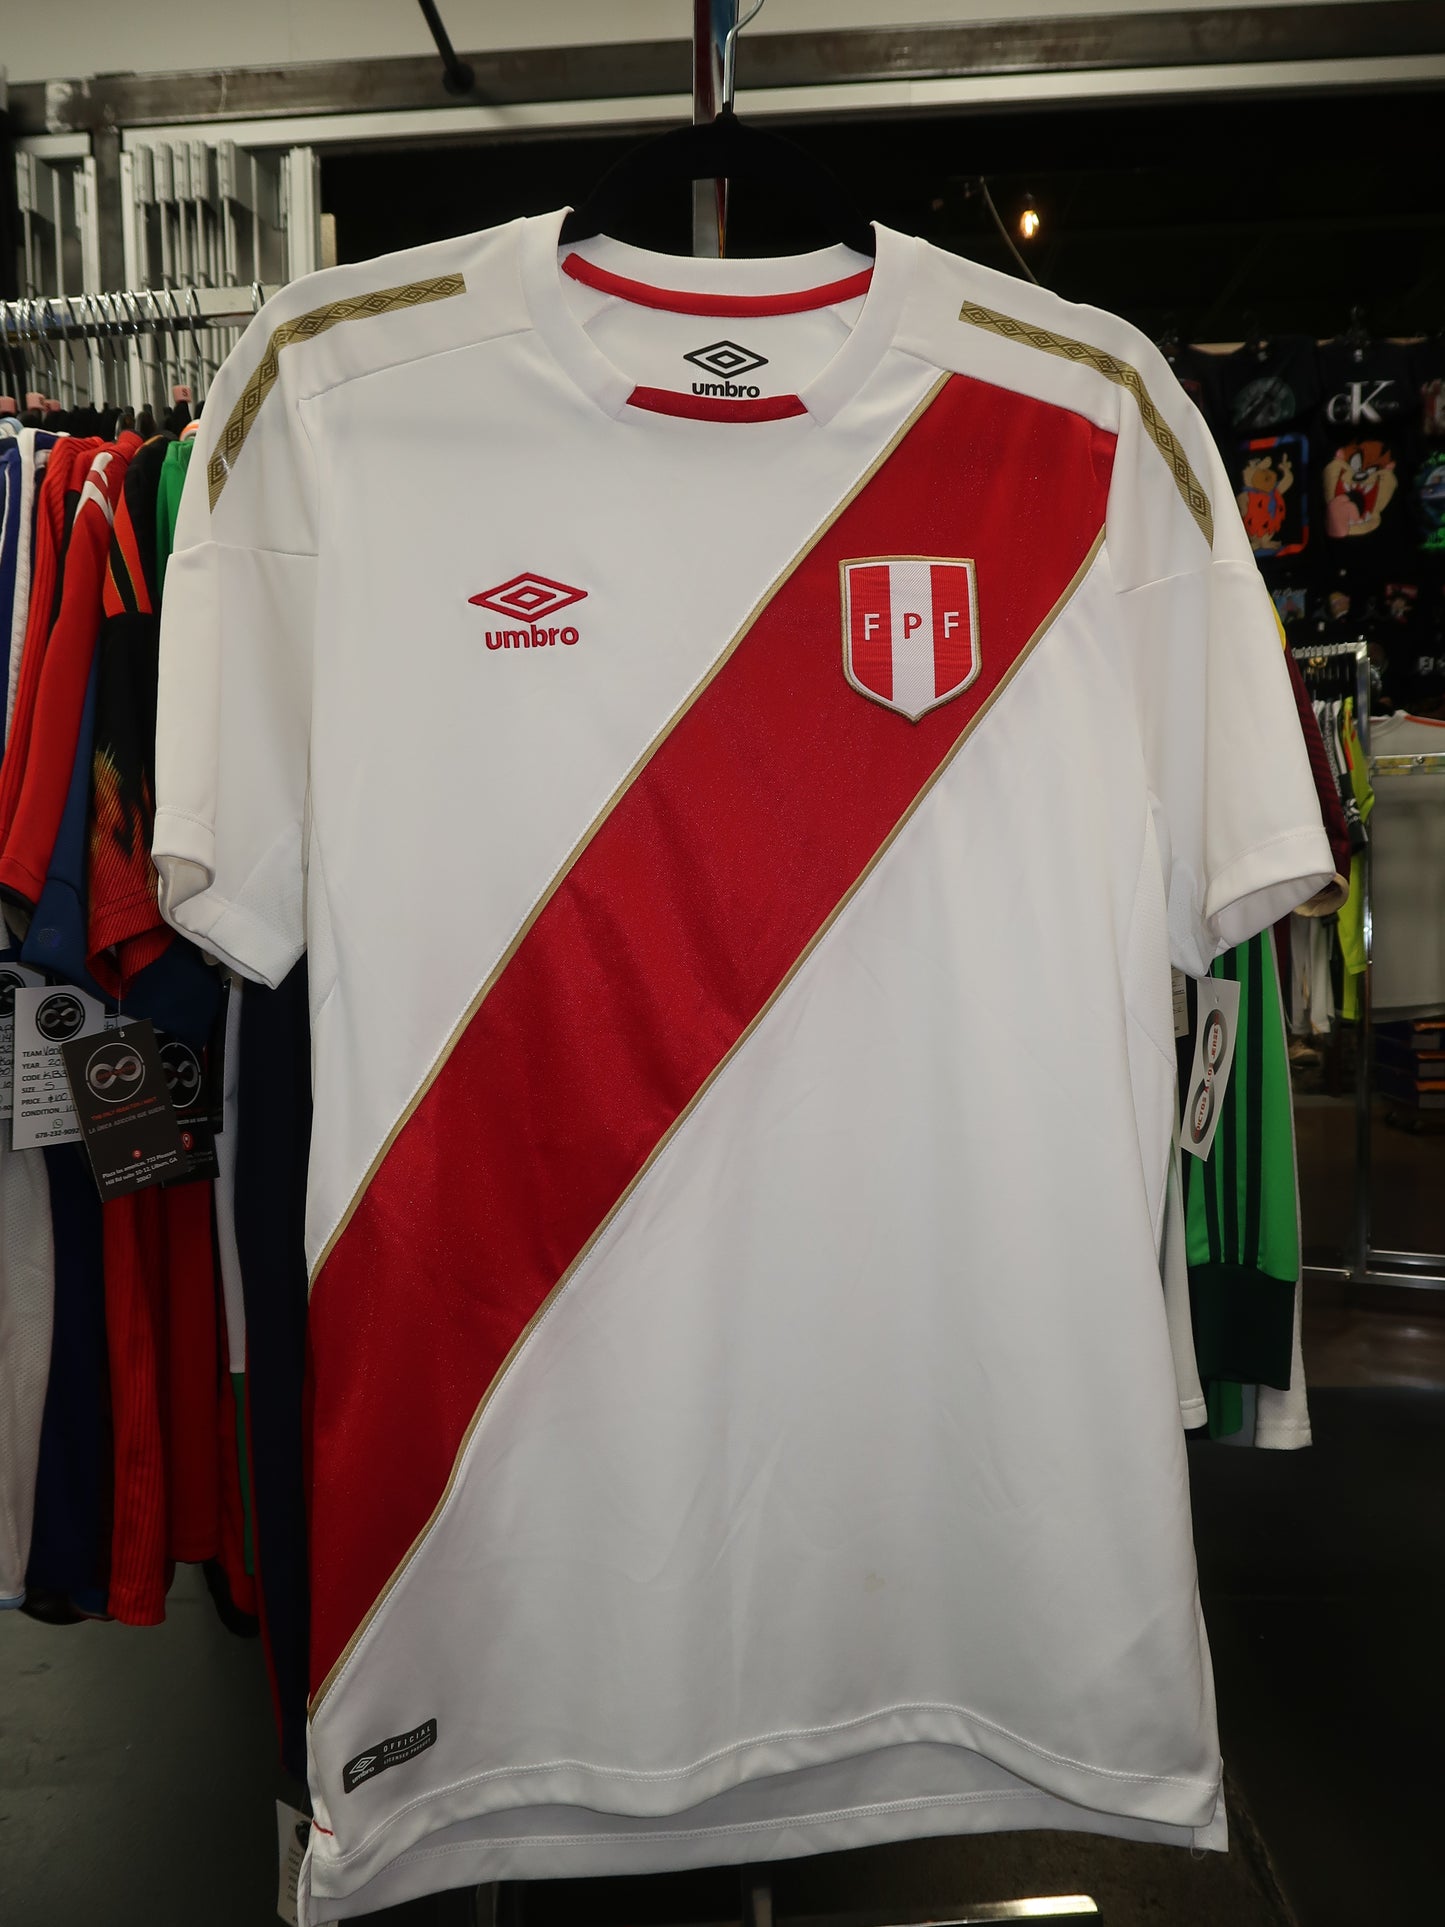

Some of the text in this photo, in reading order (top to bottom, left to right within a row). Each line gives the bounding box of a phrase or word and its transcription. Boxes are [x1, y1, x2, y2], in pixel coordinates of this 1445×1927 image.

[692, 381, 760, 398] umbro
[485, 624, 579, 650] umbro
[22, 1050, 42, 1058] TEAM
[22, 1074, 41, 1082] CODE
[21, 1098, 41, 1106] PRICE
[21, 1108, 60, 1118] CONDITION
[383, 1726, 431, 1753] OFFICIAL
[352, 1766, 375, 1784] umbro
